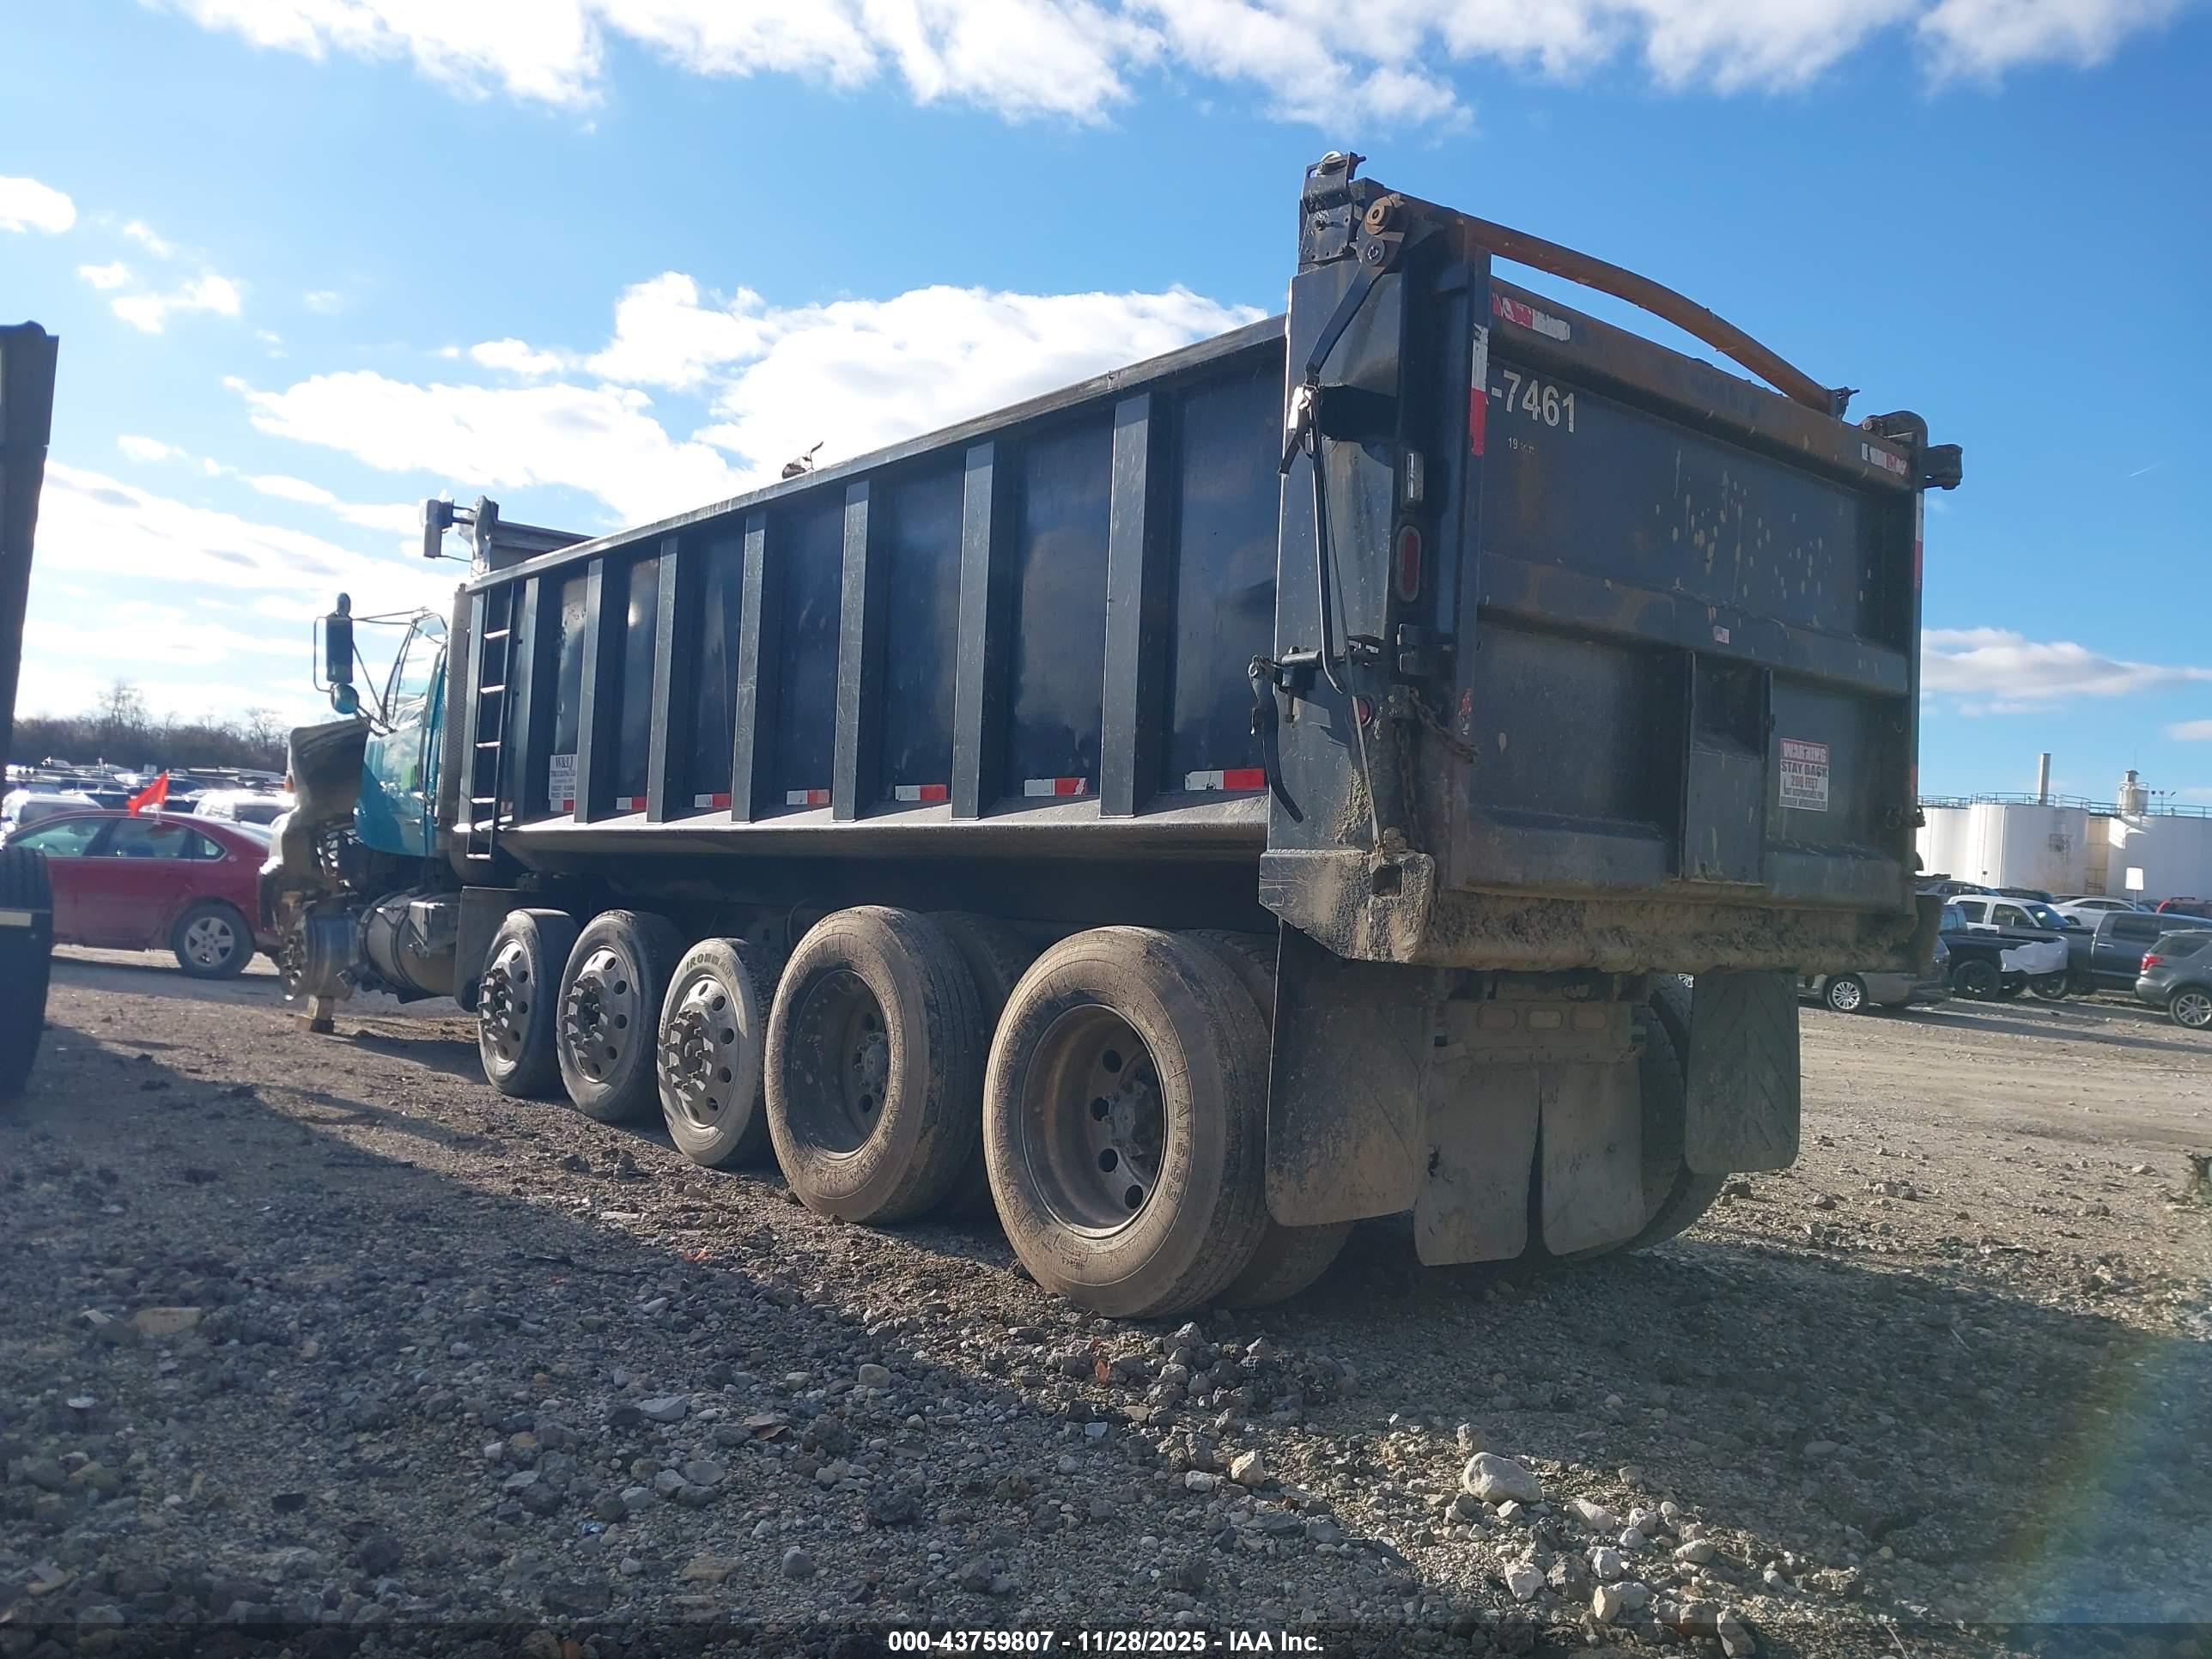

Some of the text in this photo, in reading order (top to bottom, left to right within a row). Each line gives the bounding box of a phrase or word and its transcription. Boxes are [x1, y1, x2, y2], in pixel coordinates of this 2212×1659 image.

[1783, 742, 1827, 763] WARNING
[1781, 761, 1827, 778] STAY BACK
